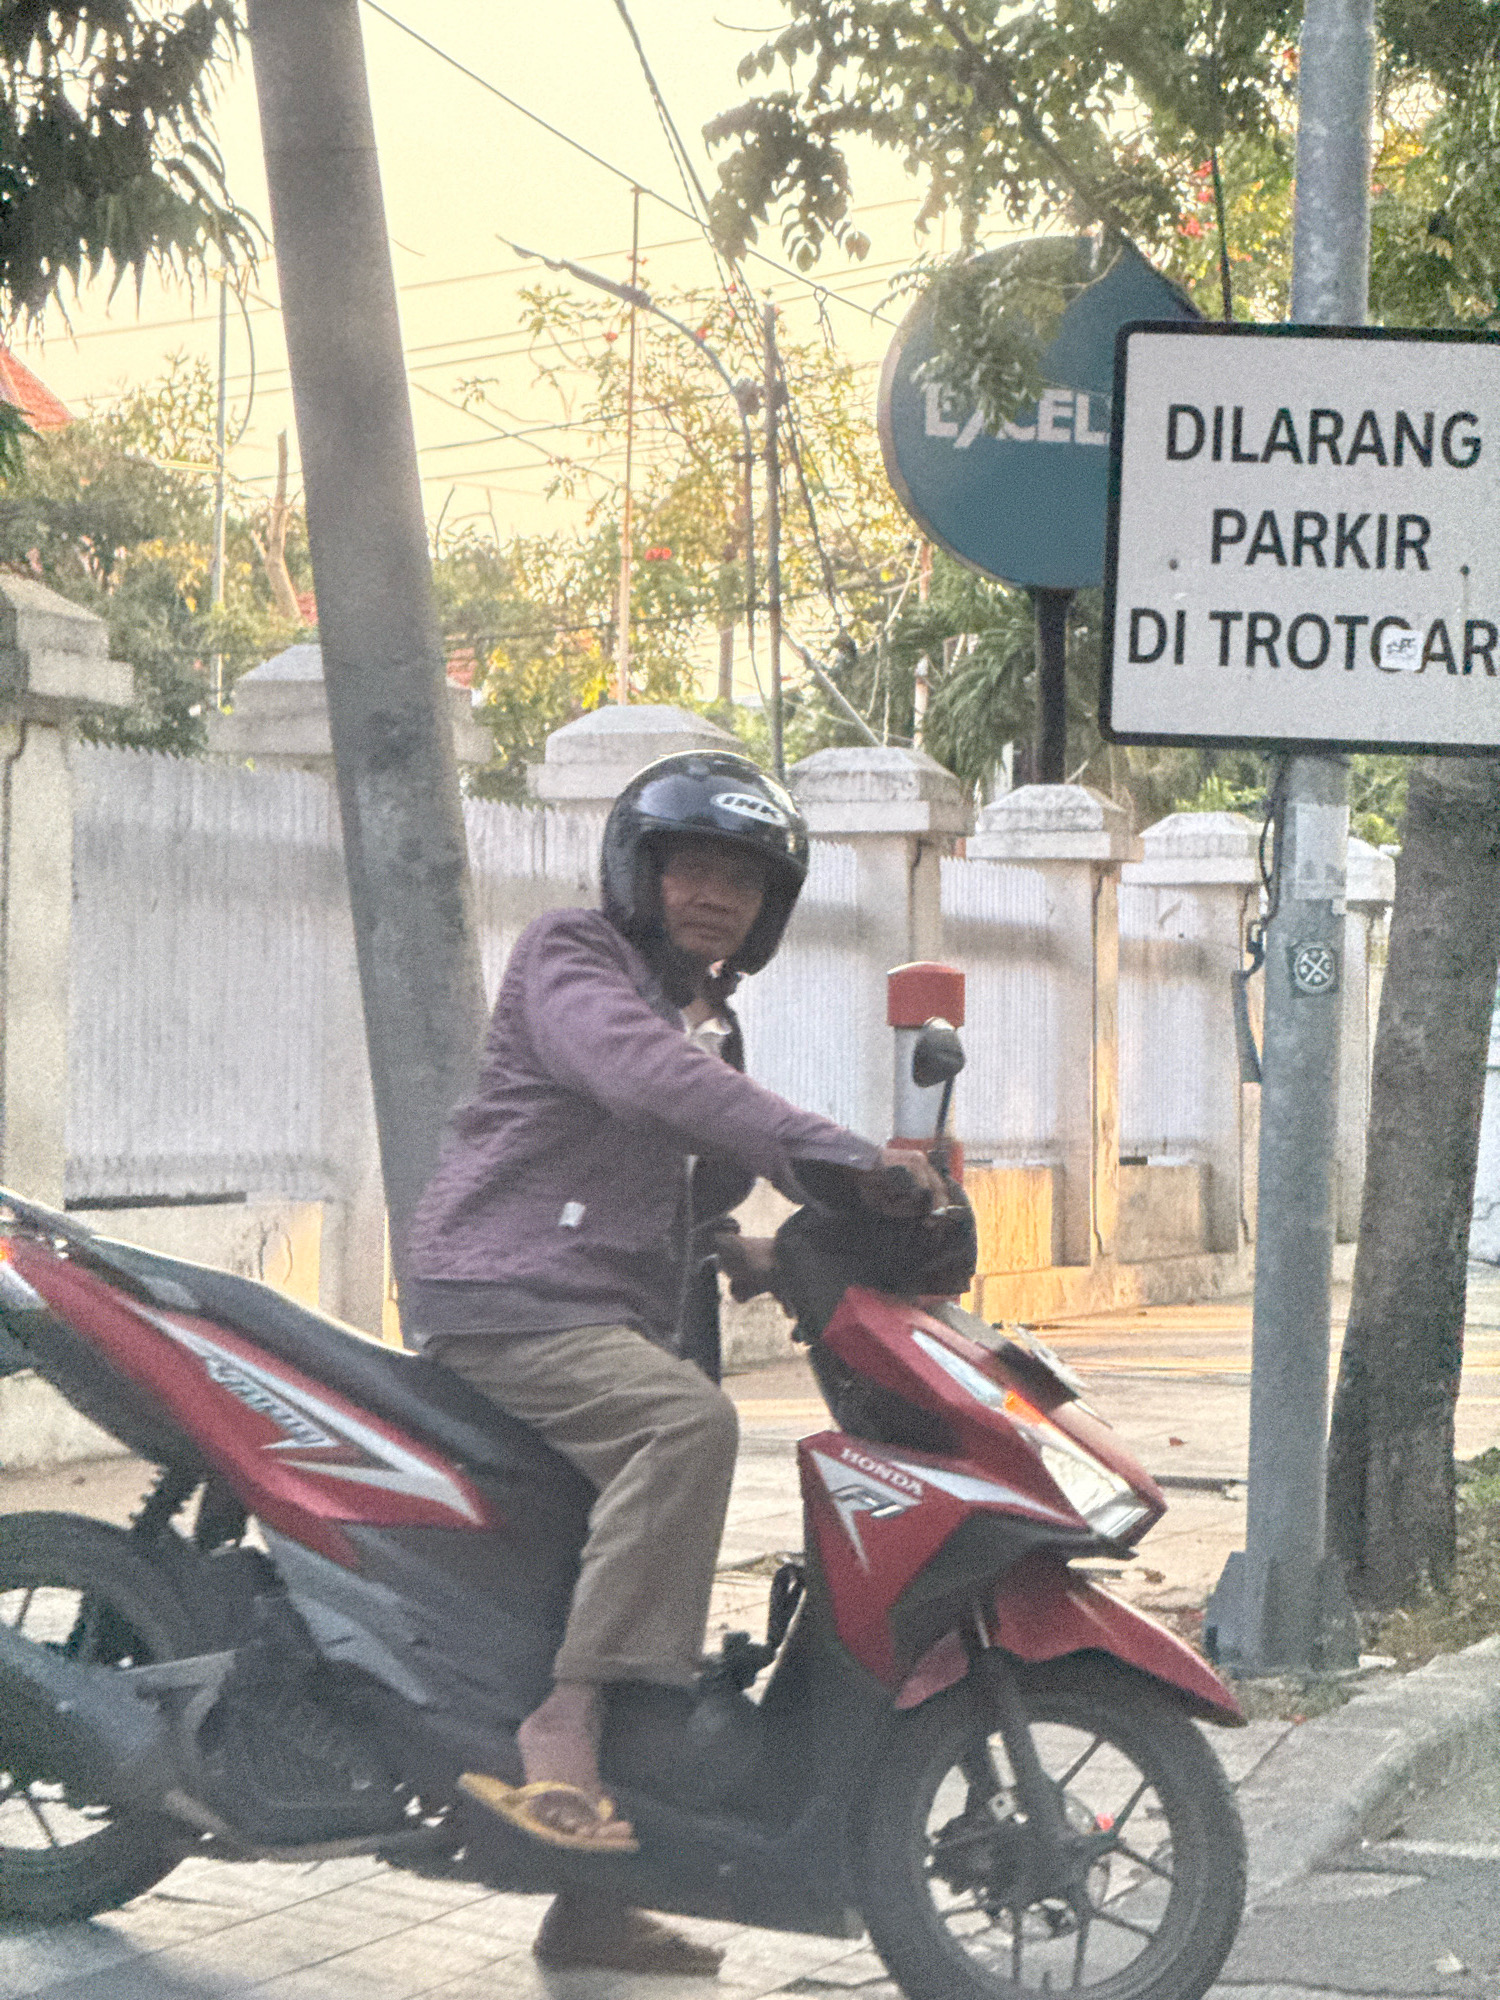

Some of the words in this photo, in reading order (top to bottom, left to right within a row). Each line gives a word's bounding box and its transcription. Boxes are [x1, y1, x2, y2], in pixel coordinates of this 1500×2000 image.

[1165, 403, 1483, 469] DILARANG
[1210, 507, 1432, 571] PARKIR
[1127, 607, 1187, 665] DI
[840, 1448, 923, 1496] HONDA
